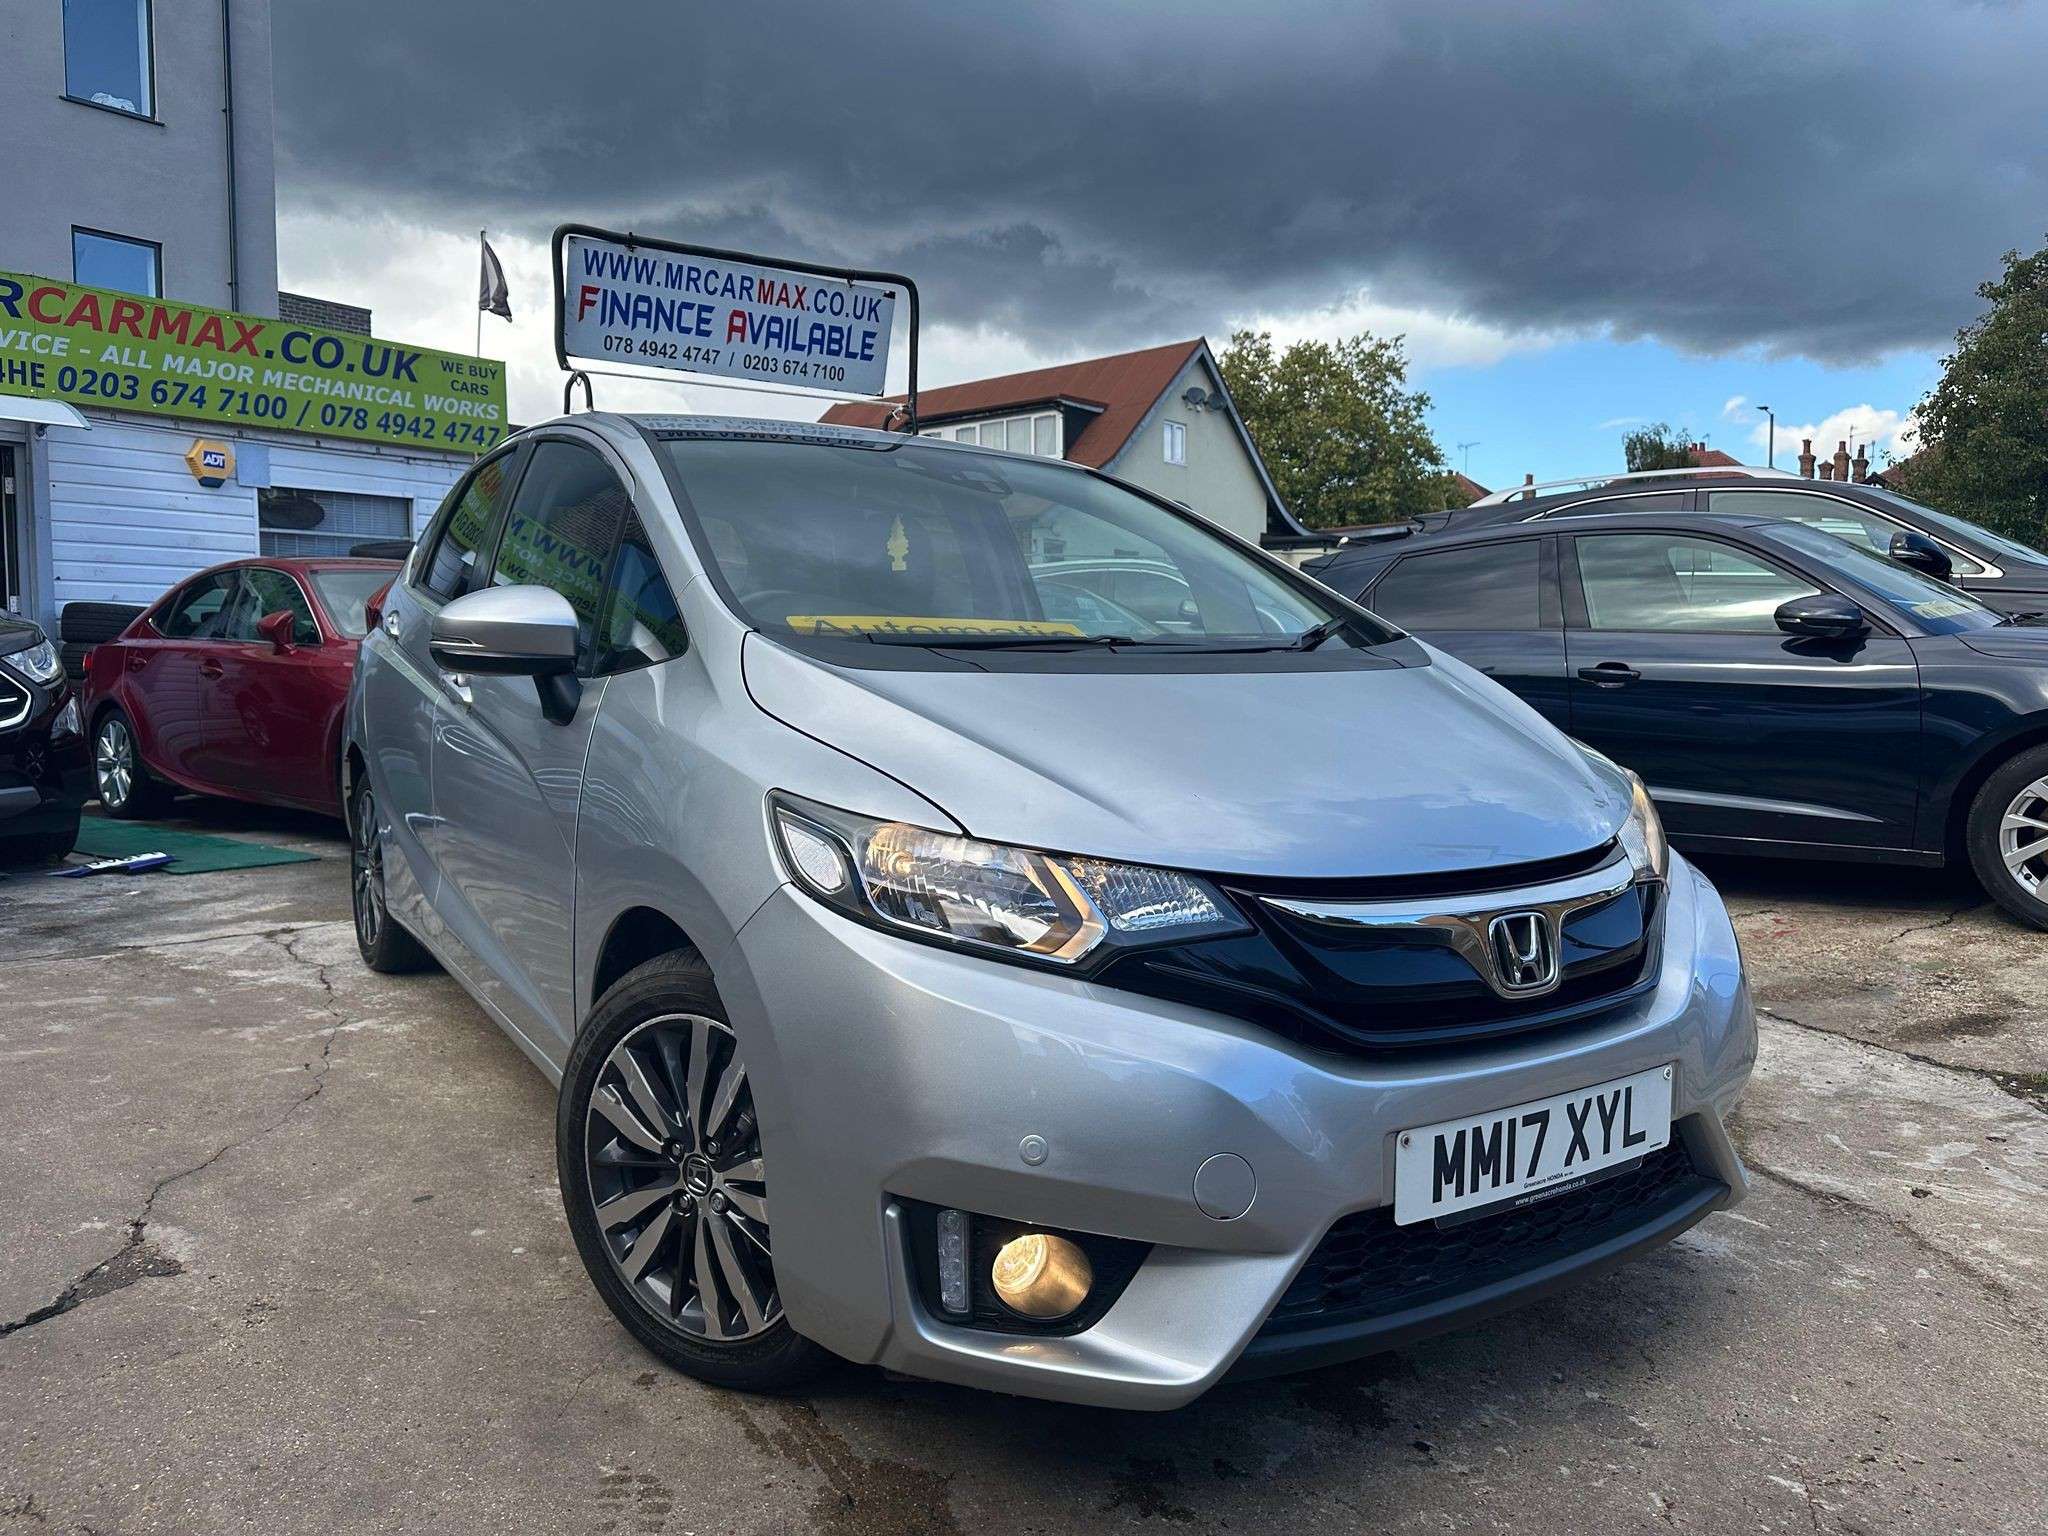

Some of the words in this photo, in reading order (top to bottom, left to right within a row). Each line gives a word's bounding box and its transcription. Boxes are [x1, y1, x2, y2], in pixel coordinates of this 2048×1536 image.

[578, 285, 715, 338] FINANCE
[726, 309, 878, 361] AVAILABLE
[583, 248, 881, 323] WWW.MRCARMAX.CO.UK
[100, 345, 152, 370] ALL
[162, 354, 254, 384] MAJOR
[263, 369, 415, 408] MECHANICAL
[424, 394, 499, 420] WORKS
[441, 360, 463, 374] WE
[469, 365, 498, 380] BUY
[450, 379, 489, 396] CARS
[603, 335, 634, 354] 078
[638, 338, 678, 360] 4942
[682, 345, 721, 365] 4747
[743, 352, 779, 372] 0203
[783, 360, 809, 378] 674
[813, 363, 845, 382] 7100
[58, 366, 140, 400] 0203
[151, 380, 206, 408] 674
[219, 388, 287, 420] 7100
[321, 403, 368, 431] 078
[376, 412, 436, 440] 4942
[444, 422, 500, 448] 4747
[203, 453, 226, 467] ADT
[1432, 1109, 1551, 1203] MM17
[1564, 1086, 1646, 1168] XYL
